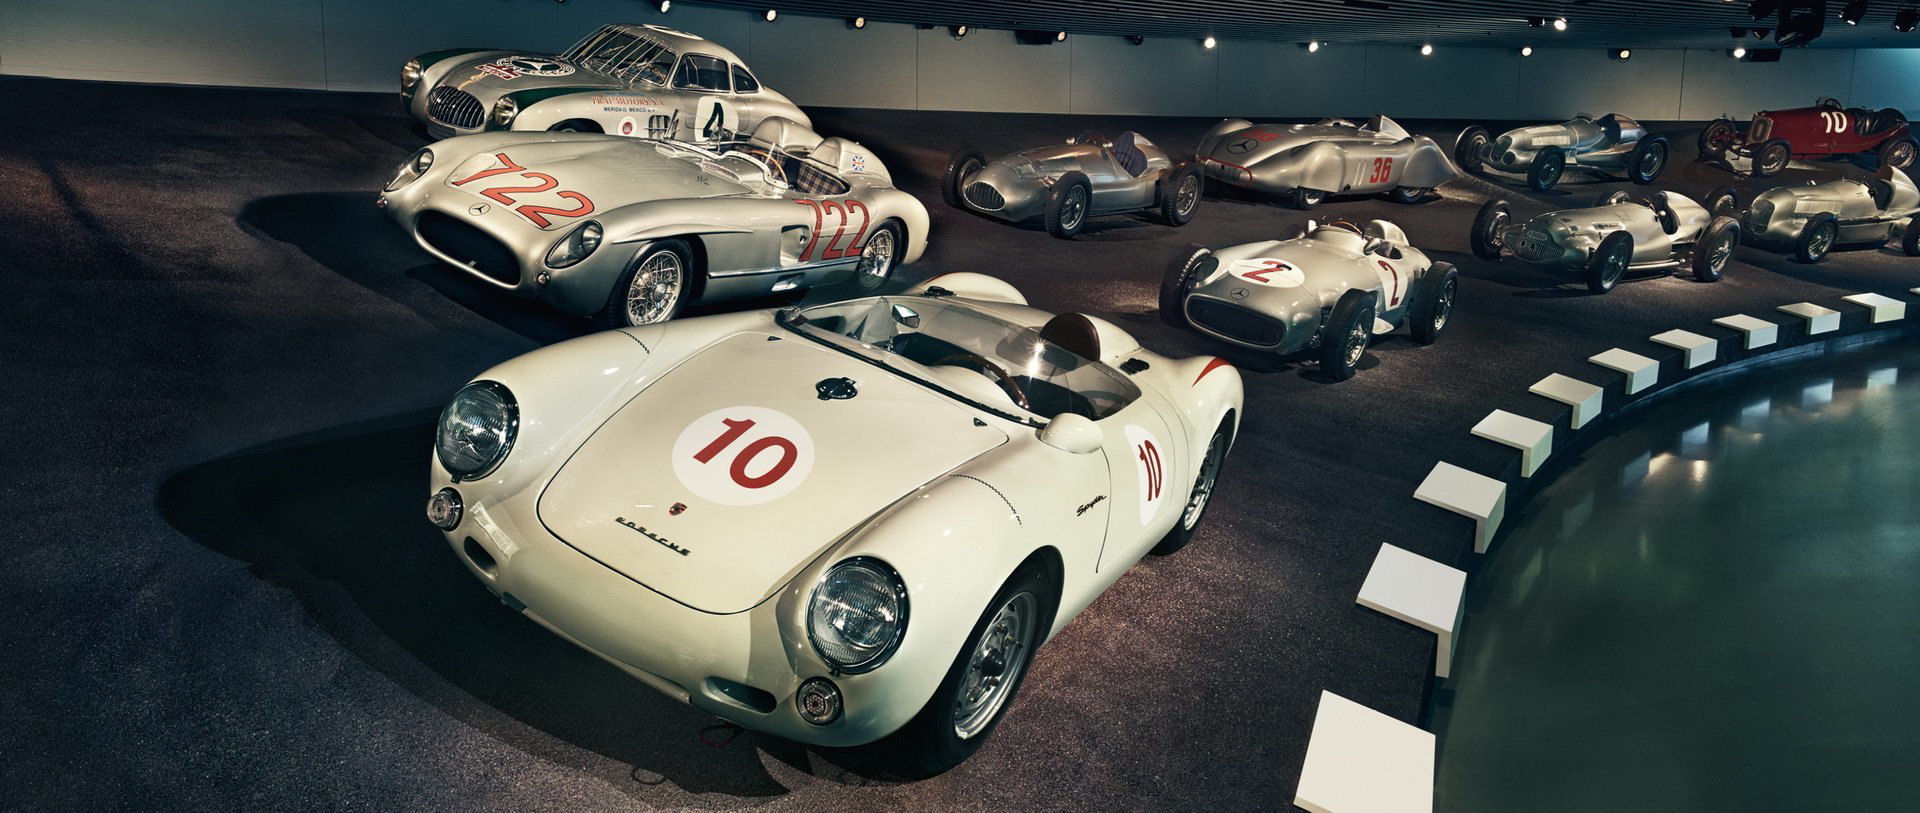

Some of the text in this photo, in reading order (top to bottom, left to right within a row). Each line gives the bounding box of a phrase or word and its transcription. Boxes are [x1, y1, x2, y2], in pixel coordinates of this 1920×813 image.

[702, 102, 725, 137] 4
[1820, 111, 1848, 134] 10
[451, 153, 595, 229] 722
[1186, 160, 1217, 194] 36
[792, 198, 870, 262] 722
[1241, 260, 1293, 284] 2
[1377, 260, 1399, 307] 2
[692, 417, 799, 489] 10
[1138, 440, 1162, 501] 10
[1076, 495, 1107, 517] Spyder
[614, 516, 691, 556] PORSCHE
